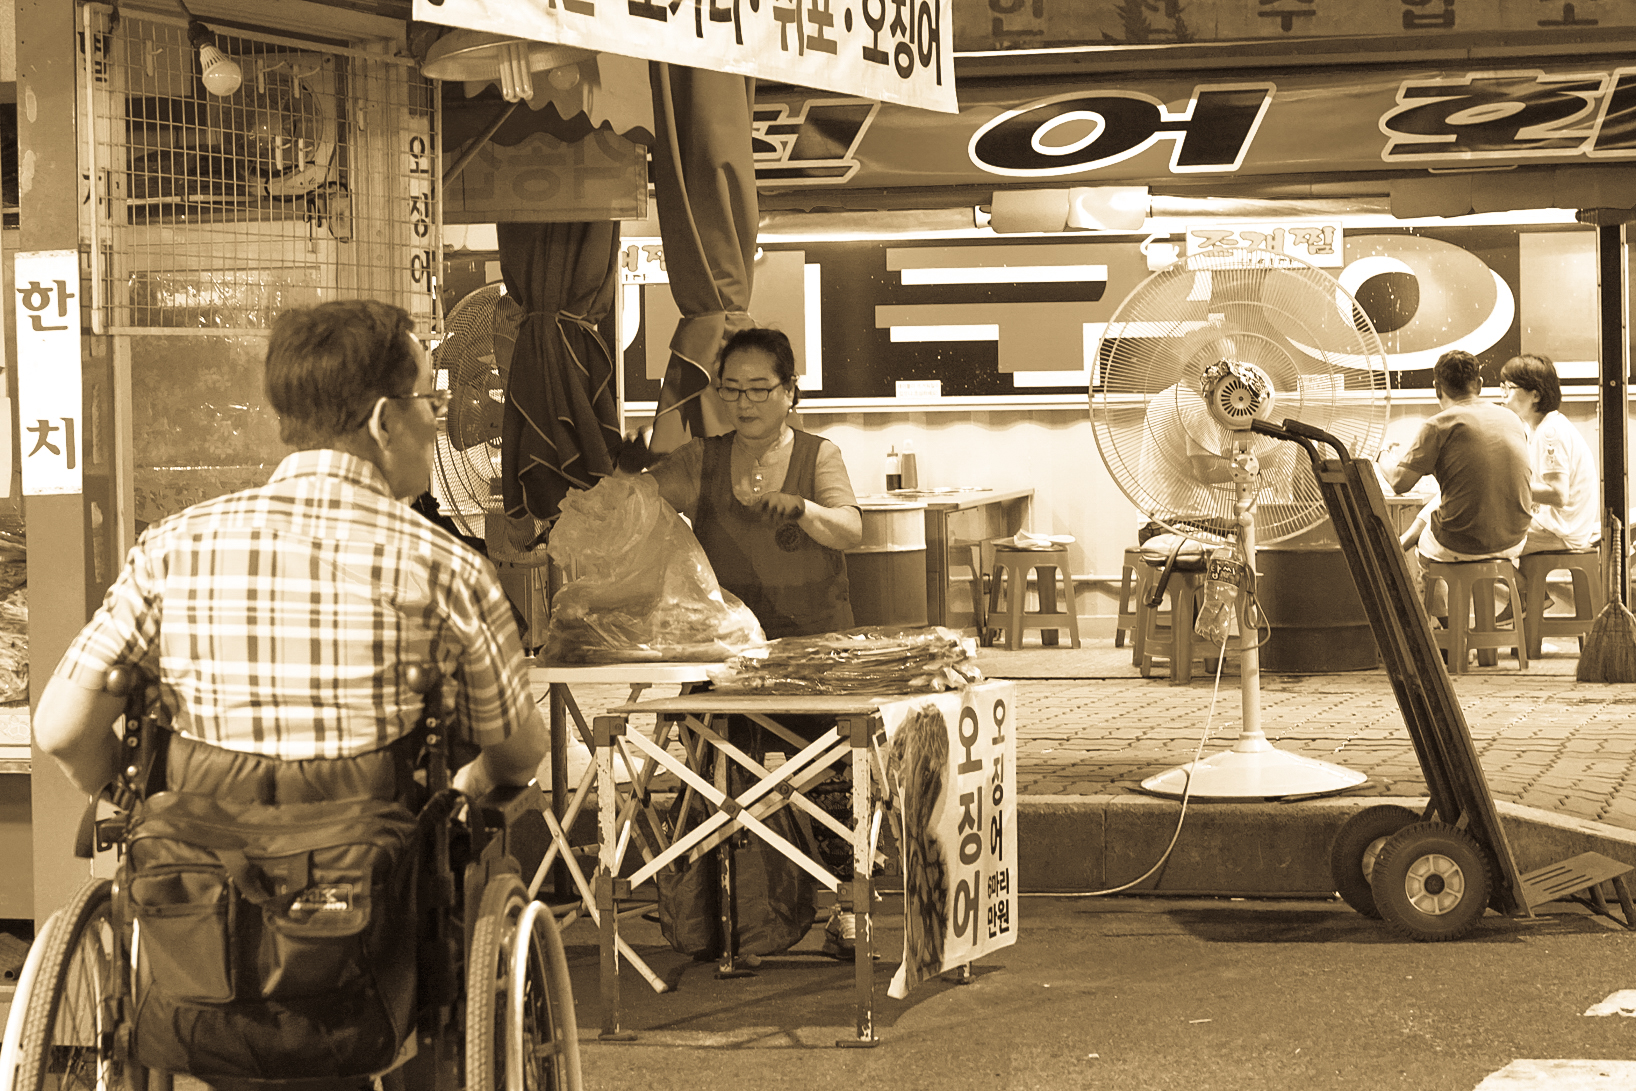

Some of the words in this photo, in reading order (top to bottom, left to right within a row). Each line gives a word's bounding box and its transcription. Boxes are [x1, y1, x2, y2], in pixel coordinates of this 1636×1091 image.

[409, 136, 432, 292] 오징어
[1190, 225, 1336, 258] 조개찜
[16, 280, 76, 470] 한치
[953, 706, 984, 947] 오징어
[990, 698, 1006, 862] 오징어
[987, 867, 1010, 899] 6마리
[987, 899, 1010, 939] 만원
